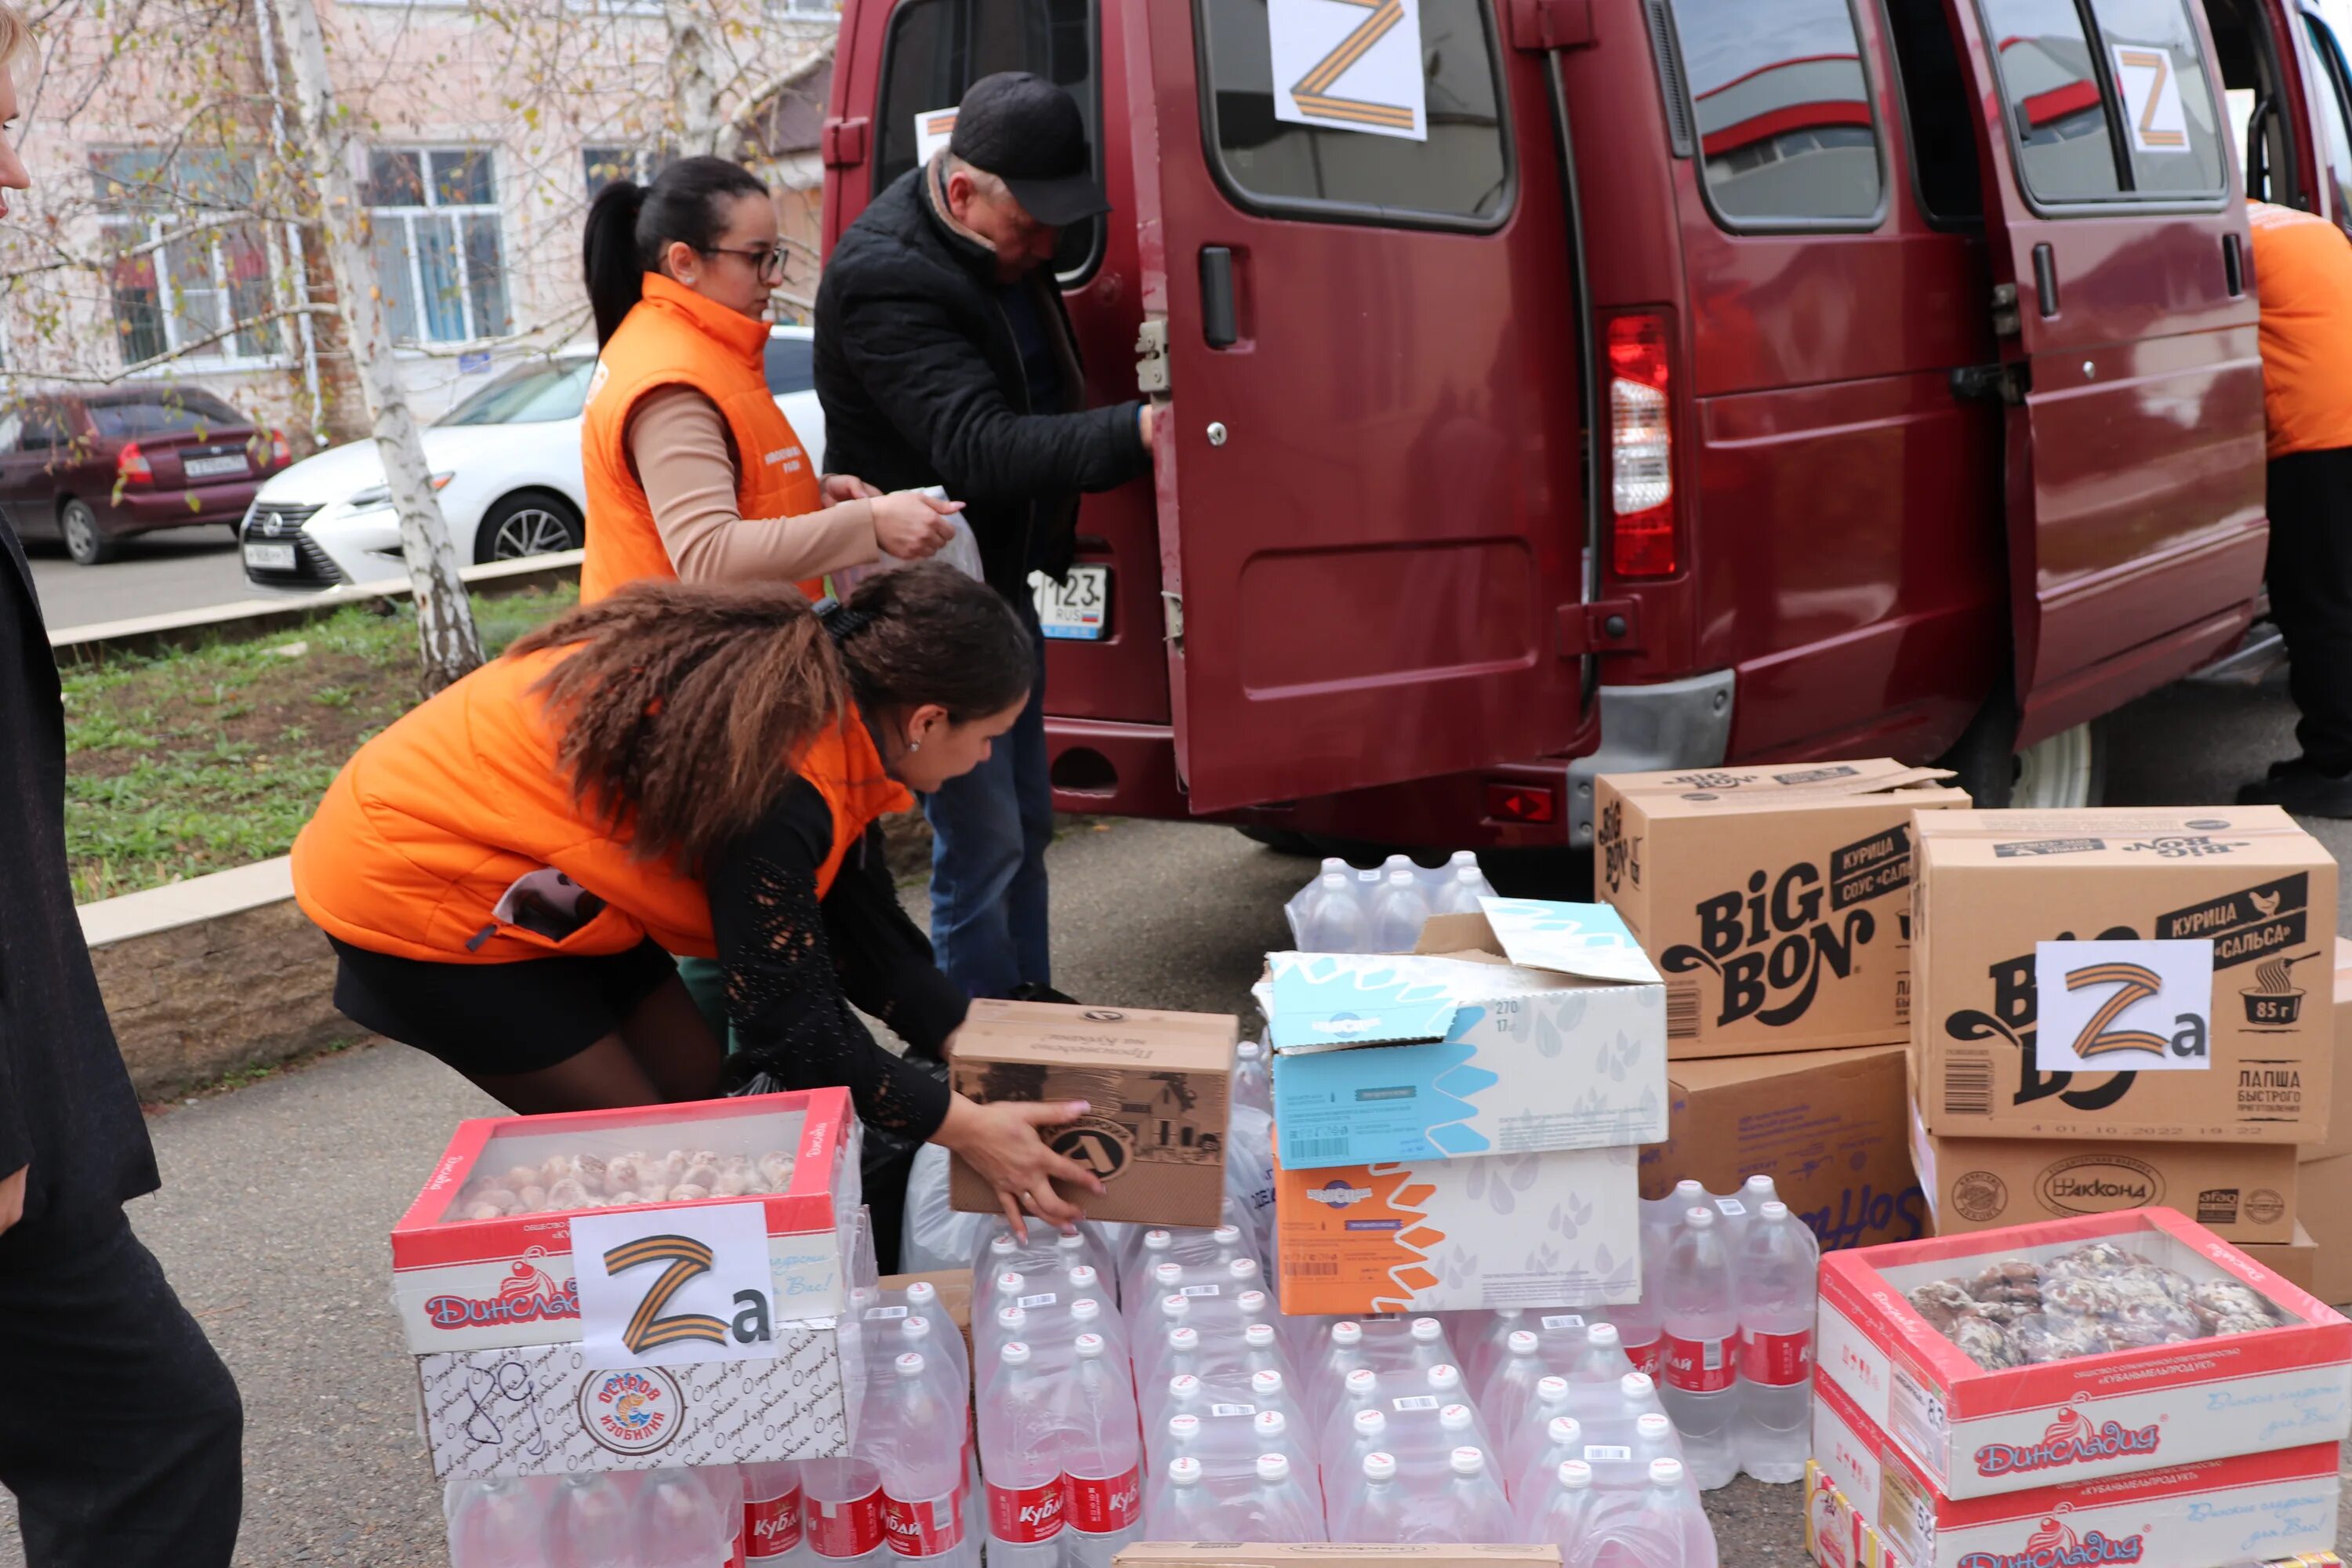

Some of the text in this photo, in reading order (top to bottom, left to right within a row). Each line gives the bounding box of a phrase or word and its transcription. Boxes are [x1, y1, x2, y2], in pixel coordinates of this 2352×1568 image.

[1290, 0, 1414, 129] Z
[2119, 51, 2184, 145] Z
[1048, 574, 1095, 606] 123
[1055, 608, 1080, 621] RUS
[1842, 836, 1894, 870] КУРИЦА
[1842, 875, 1875, 901] СОУС
[1696, 862, 1824, 960] BiG
[2172, 902, 2238, 938] КУРИЦА
[2214, 924, 2292, 959] «САЛЬСА»
[1661, 909, 1875, 1026] BON
[1496, 1000, 1518, 1014] 270
[2256, 1001, 2289, 1018] 85 г
[2238, 1070, 2301, 1088] ЛАПША
[2238, 1090, 2301, 1102] БЫСТРОГО
[786, 1272, 833, 1294] Вас!
[597, 1375, 662, 1404] ОСТРОВ
[600, 1411, 666, 1441] ИЗОБИЛИЯ
[1975, 1421, 2160, 1478] Динсладия
